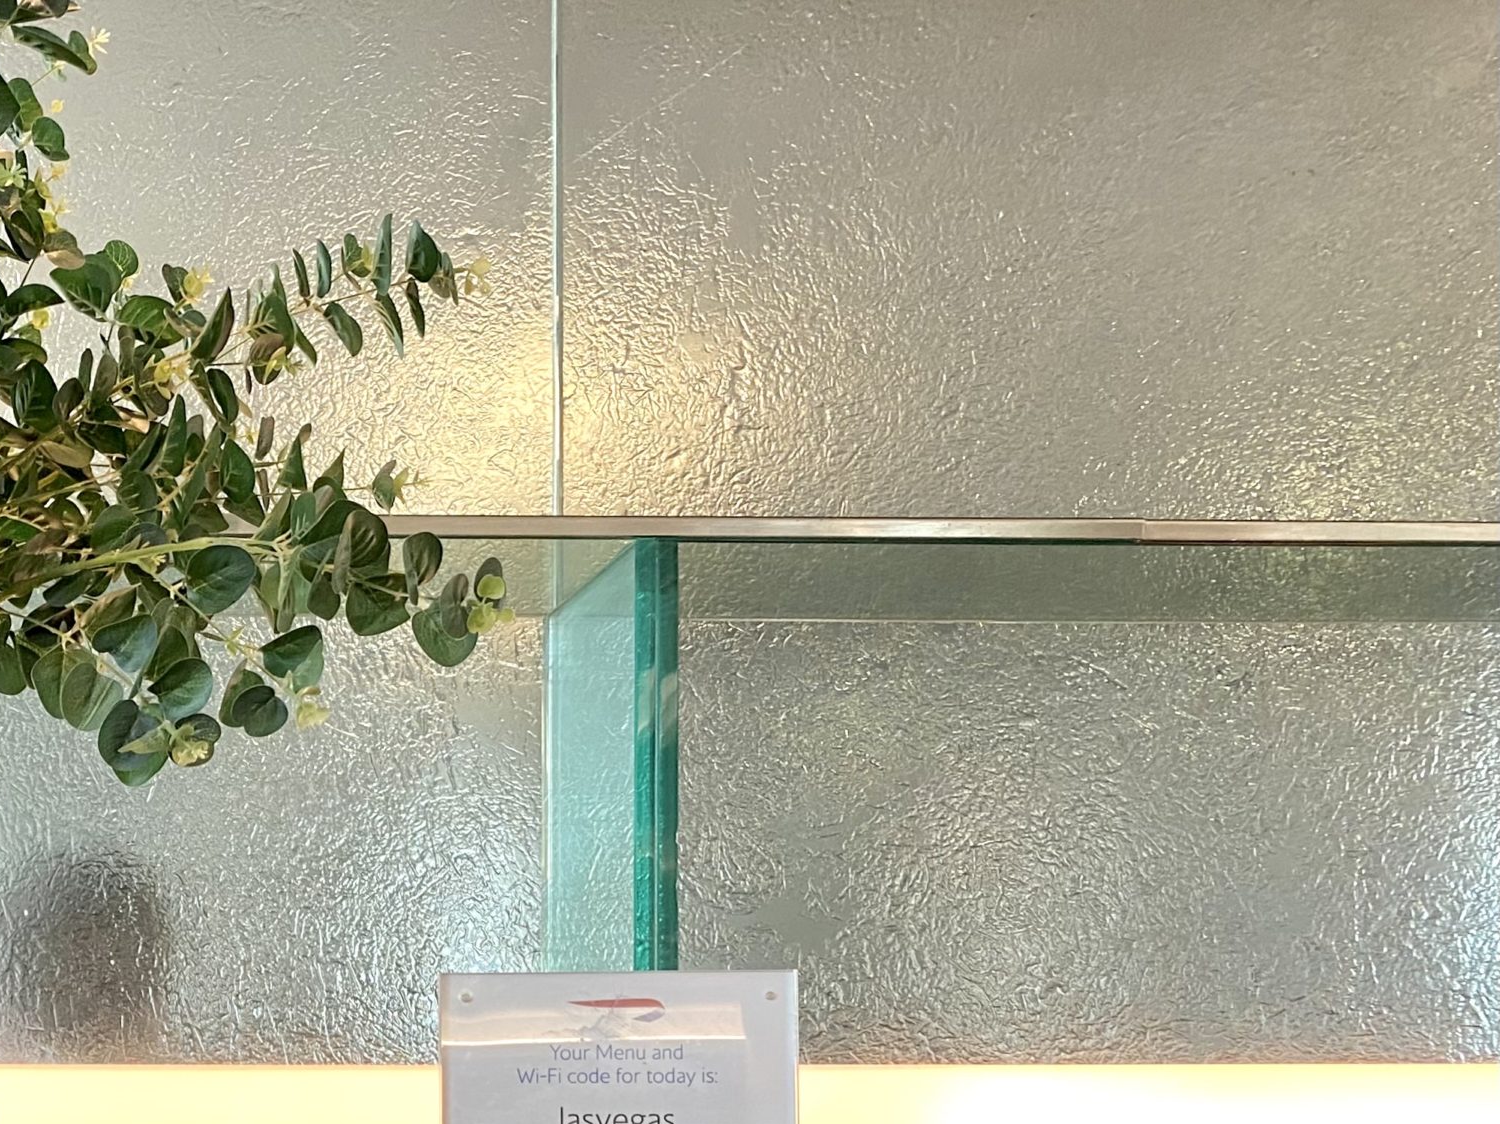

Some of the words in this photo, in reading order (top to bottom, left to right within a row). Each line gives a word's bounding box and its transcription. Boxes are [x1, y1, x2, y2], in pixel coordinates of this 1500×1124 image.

[550, 1044, 591, 1061] Your
[596, 1044, 646, 1061] Menu
[652, 1044, 684, 1060] and
[517, 1067, 562, 1084] Wi-Fi
[567, 1067, 611, 1084] code
[616, 1067, 640, 1084] for
[647, 1068, 696, 1088] today
[702, 1068, 719, 1084] is:
